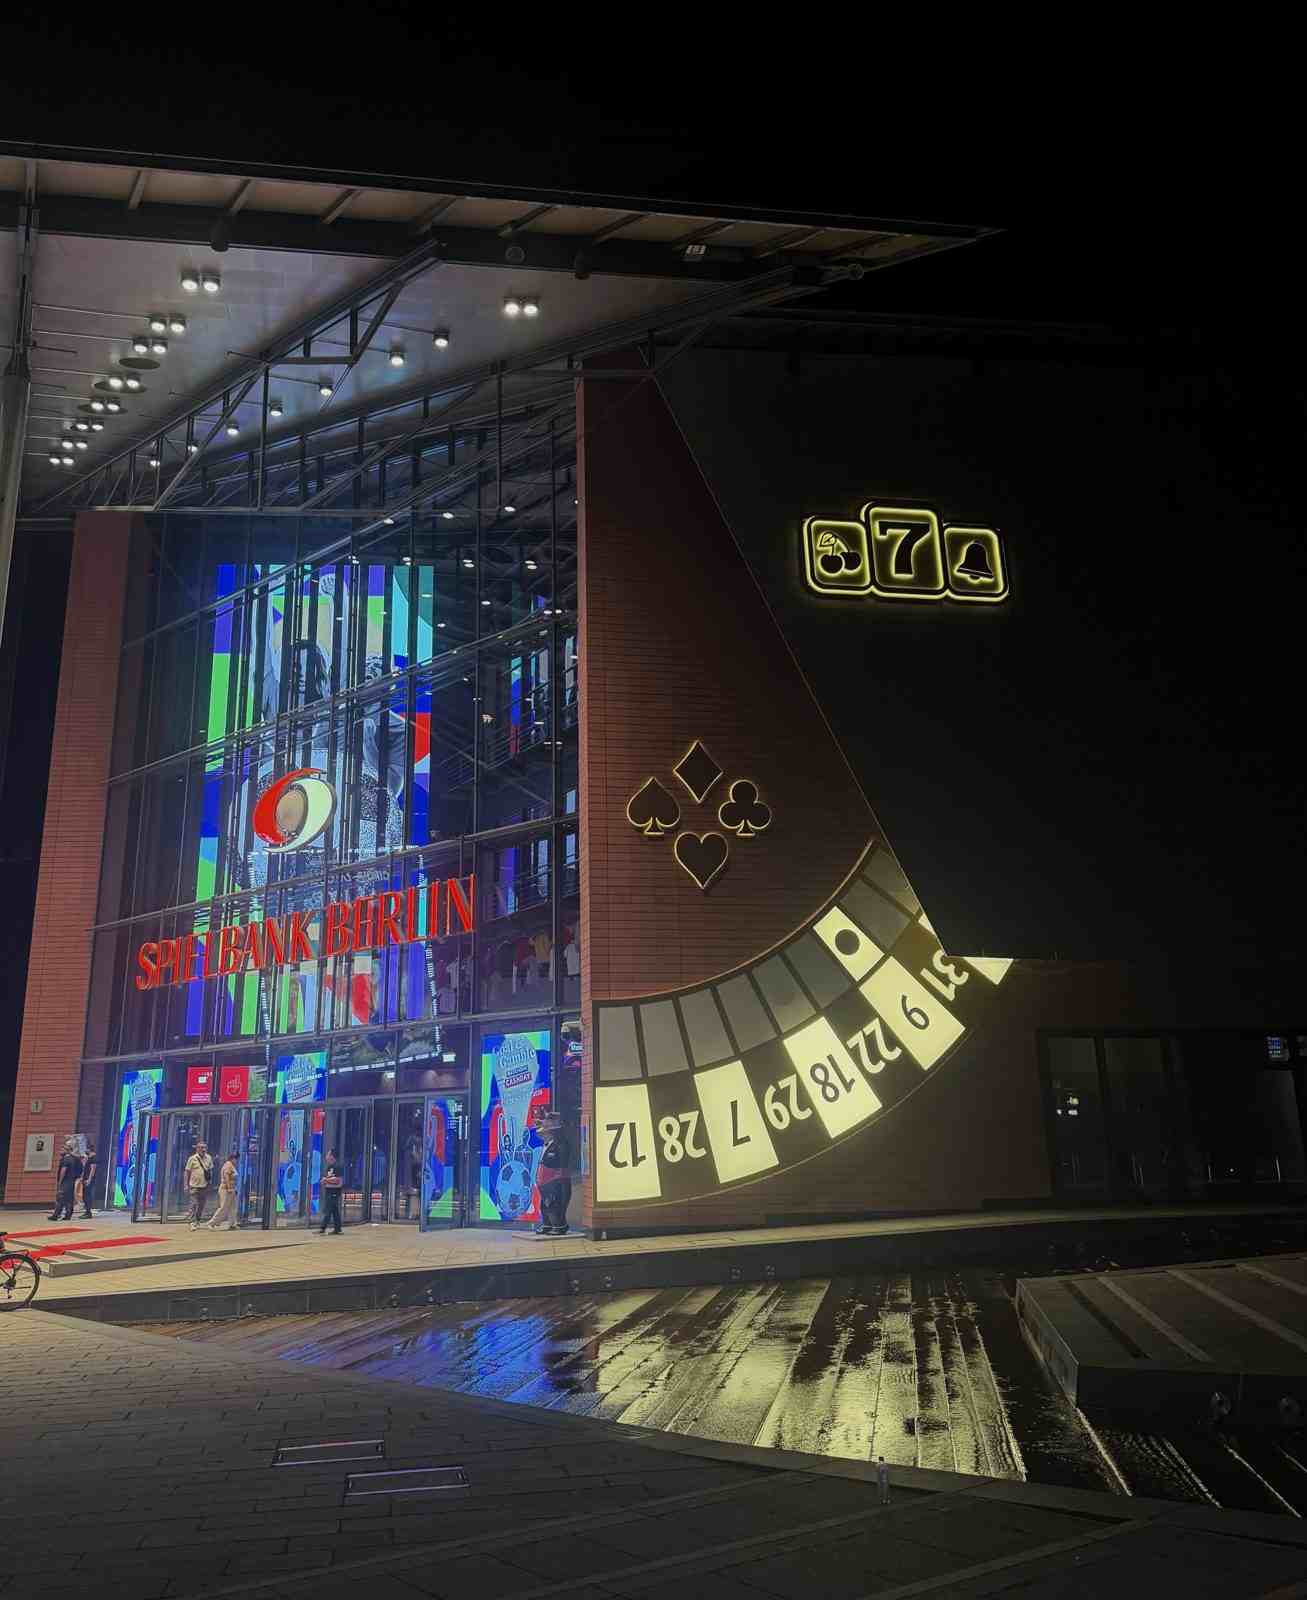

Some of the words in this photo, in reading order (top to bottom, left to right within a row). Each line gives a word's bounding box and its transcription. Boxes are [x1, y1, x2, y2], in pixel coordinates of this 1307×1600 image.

[877, 519, 931, 577] 7
[135, 910, 314, 991] SPIELBANK
[325, 873, 476, 958] BERLIN
[919, 948, 969, 1002] 31
[847, 1017, 903, 1075] 22
[763, 1073, 814, 1131] 29
[809, 1053, 856, 1104] 18
[605, 1121, 647, 1169] 12
[658, 1110, 707, 1163] 28
[730, 1099, 752, 1148] 7
